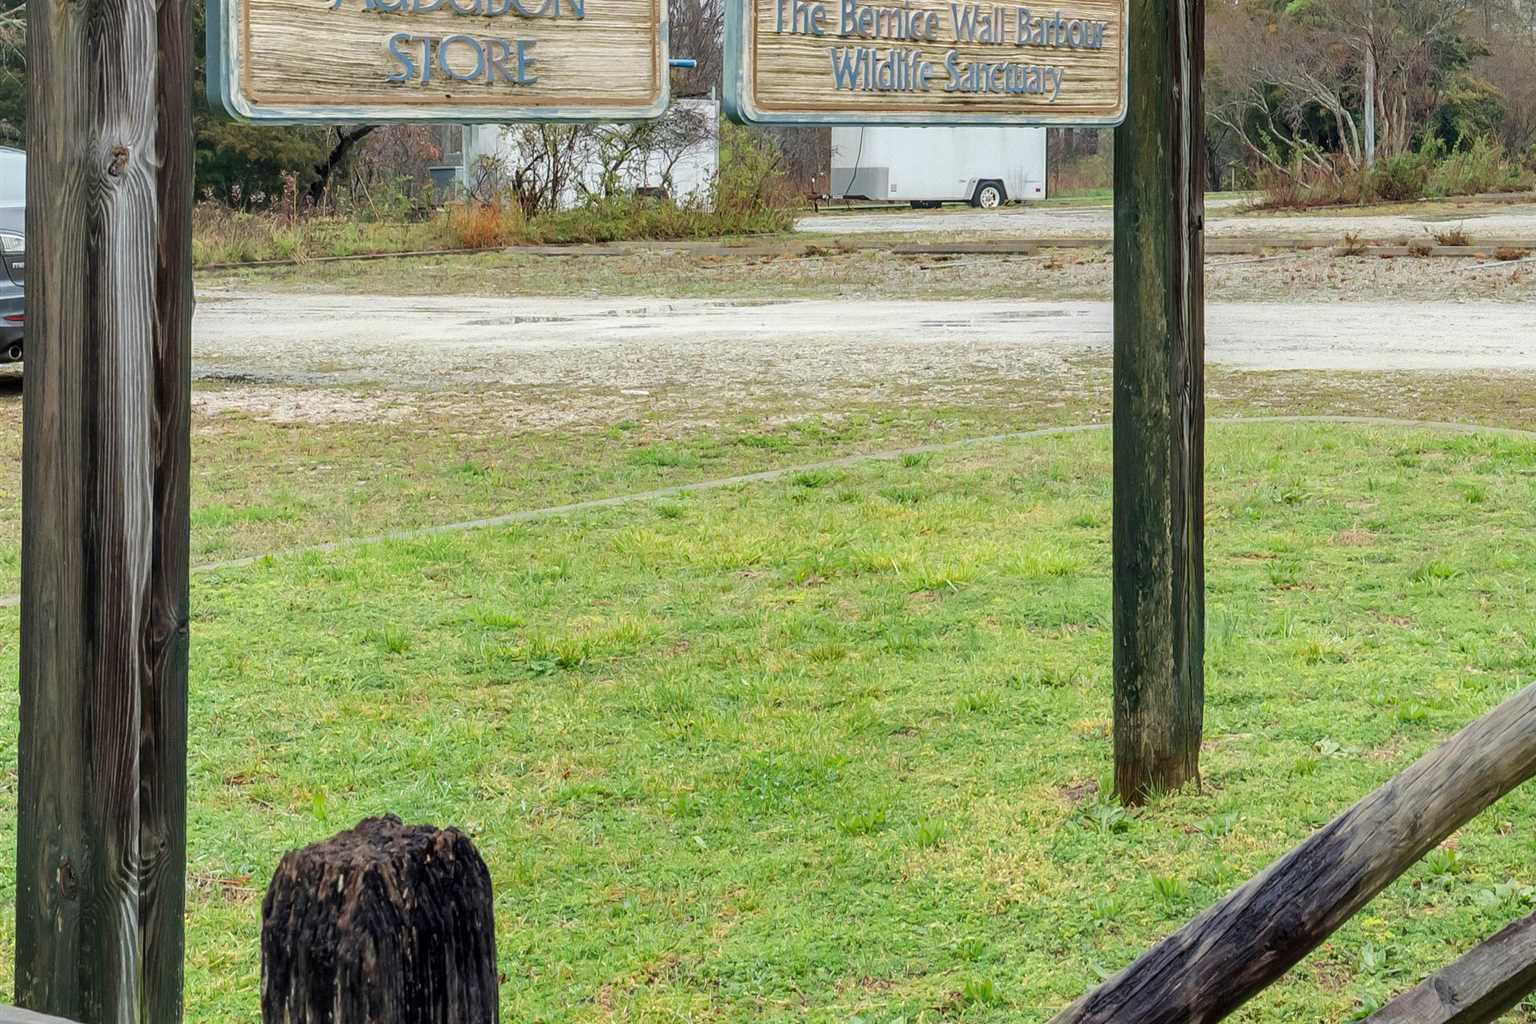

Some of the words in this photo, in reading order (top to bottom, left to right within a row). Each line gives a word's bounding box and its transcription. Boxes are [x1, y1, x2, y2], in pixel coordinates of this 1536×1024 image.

[951, 1, 1006, 44] Wall
[1015, 7, 1105, 49] Barbour
[385, 32, 538, 87] STORE
[827, 47, 932, 92] Wildlife
[943, 49, 1064, 103] Sanctuary
